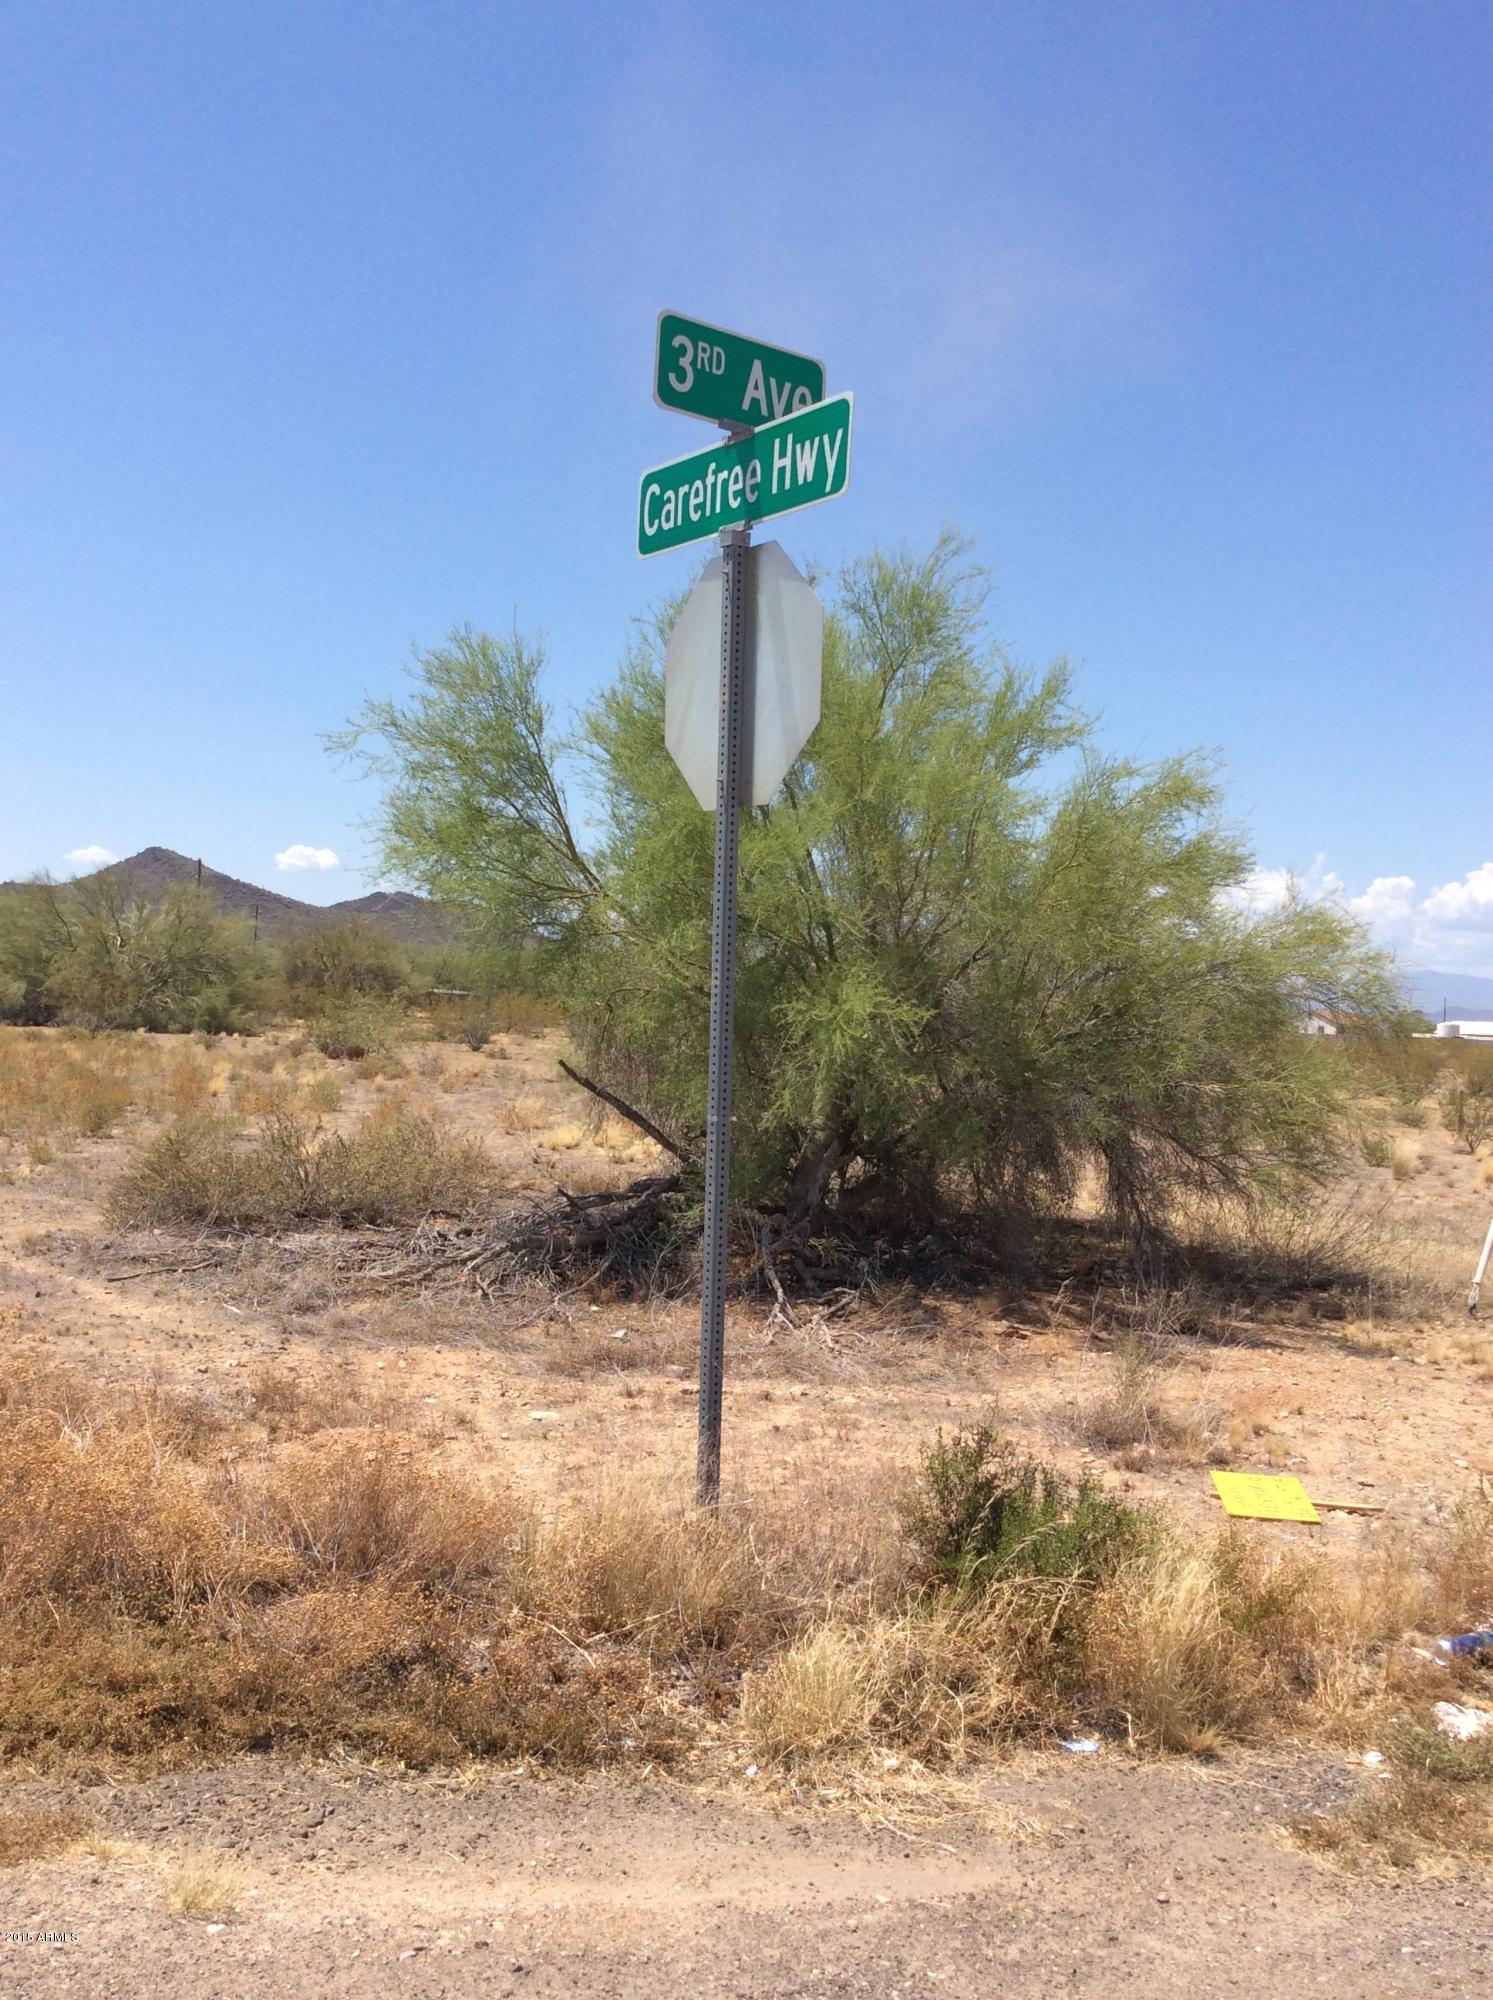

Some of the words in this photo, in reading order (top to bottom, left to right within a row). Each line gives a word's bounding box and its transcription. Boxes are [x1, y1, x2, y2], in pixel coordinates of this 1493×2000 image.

[668, 335, 726, 393] 3RD
[643, 458, 761, 537] Carefree
[771, 428, 844, 494] Hwy
